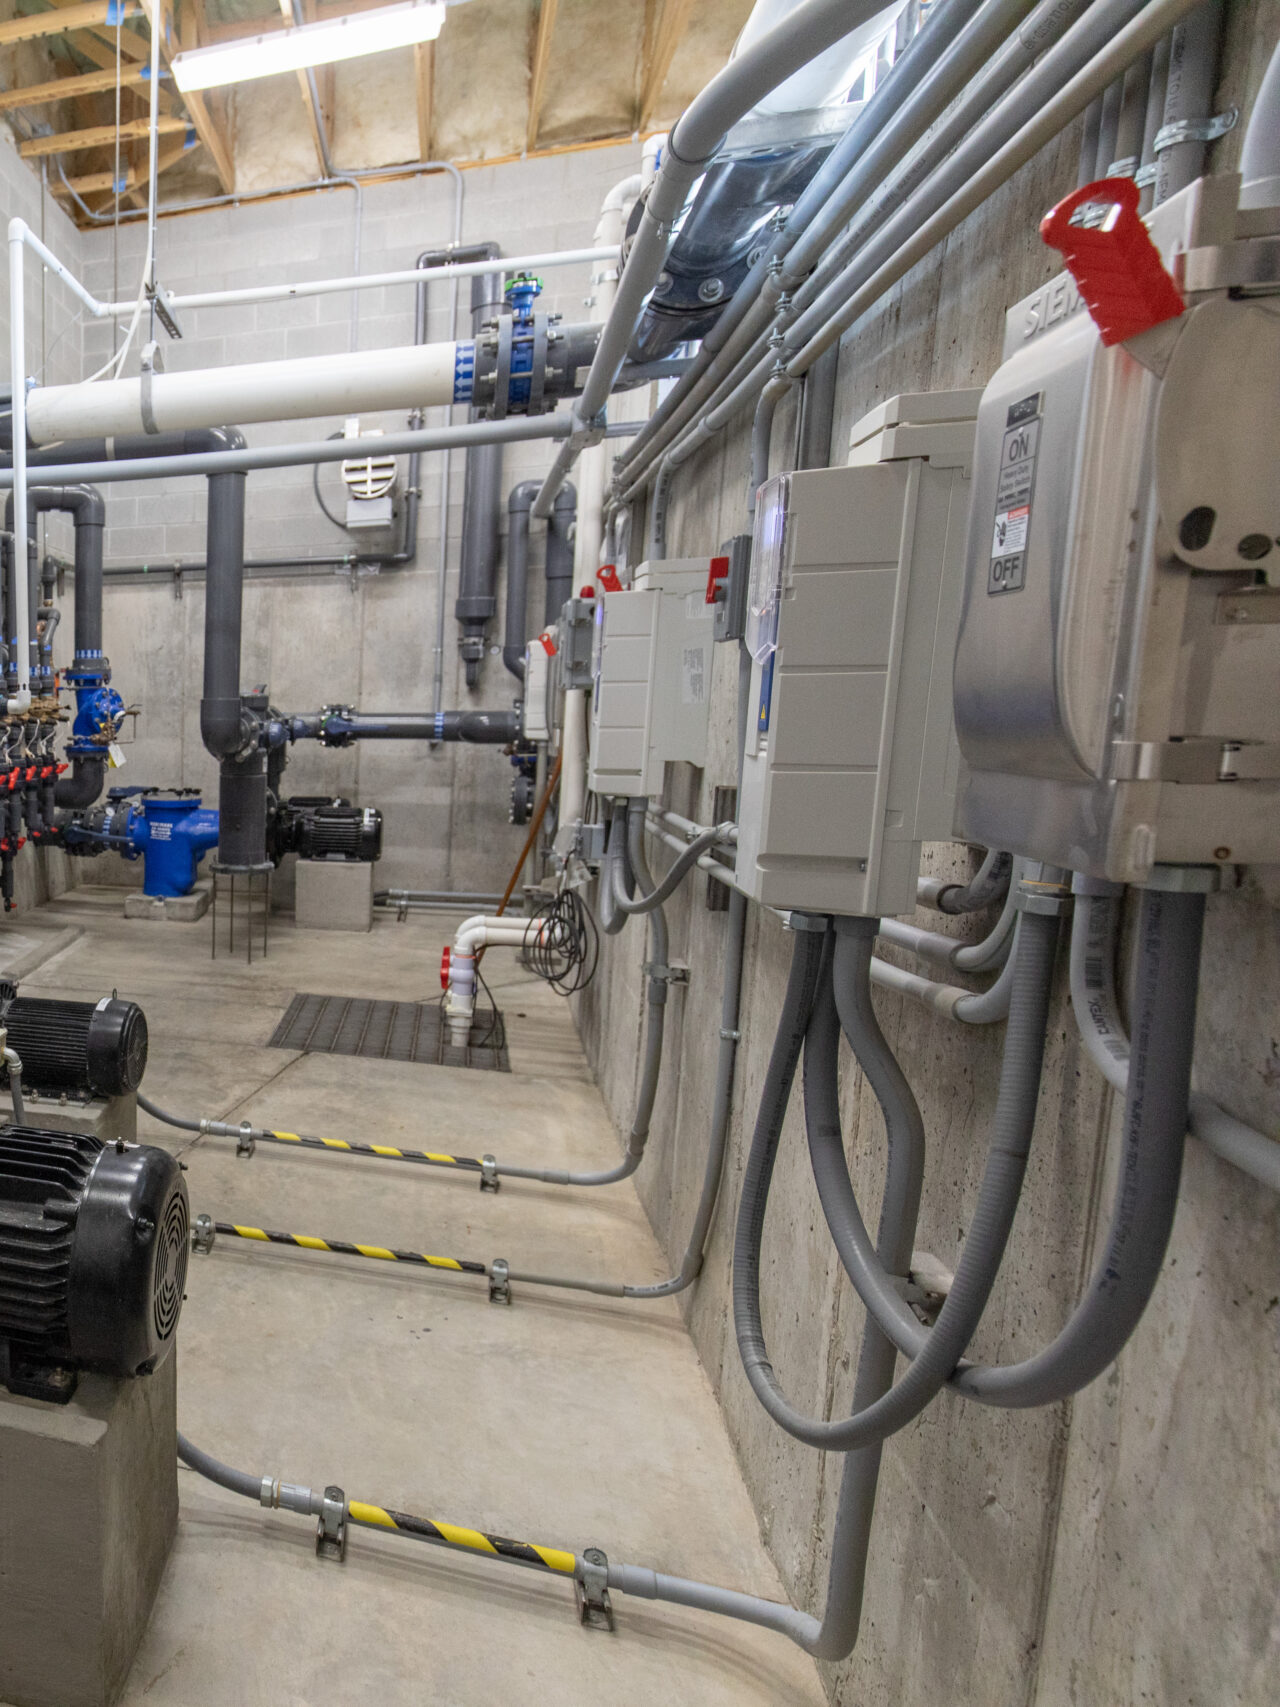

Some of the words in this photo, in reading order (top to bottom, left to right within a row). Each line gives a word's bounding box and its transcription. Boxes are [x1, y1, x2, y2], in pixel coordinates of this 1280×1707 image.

[1022, 279, 1086, 340] SIEM
[1009, 433, 1030, 462] ON
[993, 557, 1020, 582] OFF
